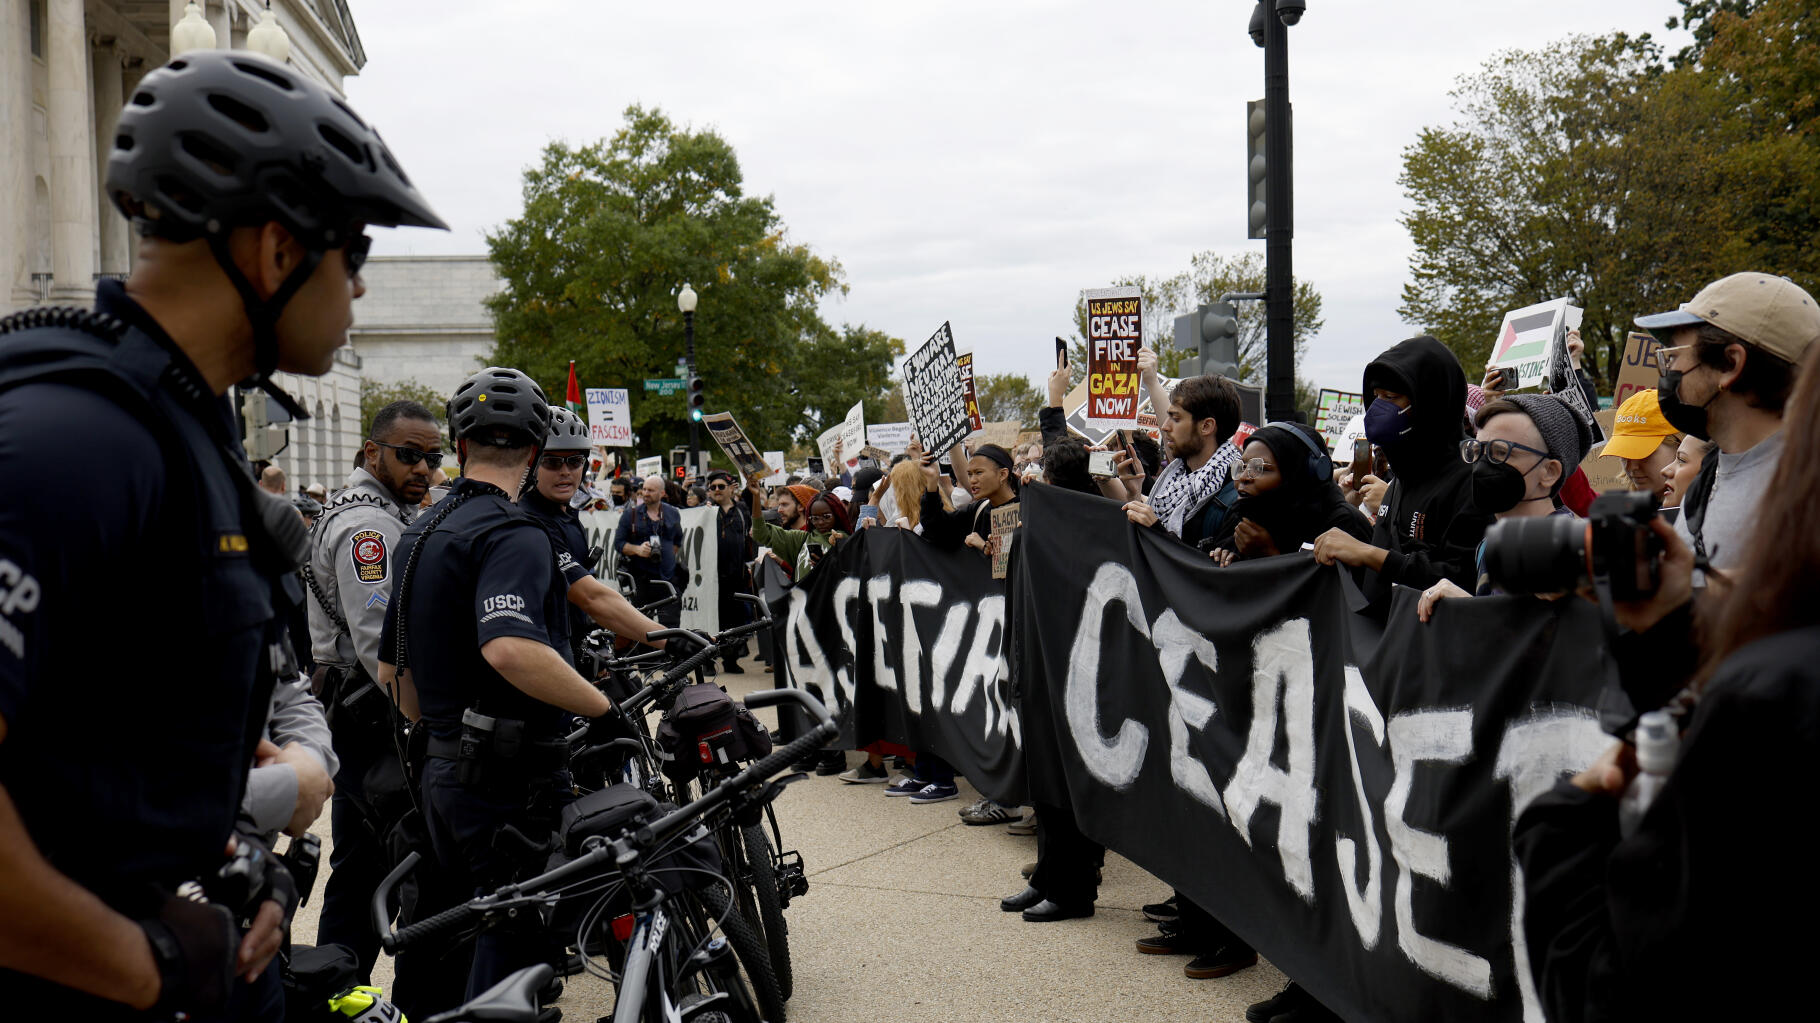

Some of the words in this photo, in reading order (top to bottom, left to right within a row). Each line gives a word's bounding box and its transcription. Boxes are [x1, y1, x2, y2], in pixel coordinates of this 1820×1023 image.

[1102, 301, 1124, 314] JEWS
[1124, 300, 1138, 313] SAY
[1091, 316, 1139, 337] CEASE
[911, 342, 930, 376] YOU
[928, 323, 949, 358] ARE
[1095, 340, 1136, 361] FIRE
[909, 342, 954, 398] NEUTRAL
[1111, 362, 1121, 371] IN
[1090, 374, 1138, 394] GAZA
[587, 391, 625, 404] ZIONISM
[942, 407, 950, 420] OF
[951, 396, 964, 413] THE
[1096, 398, 1132, 415] NOW!
[1332, 404, 1363, 415] JEWISH
[1328, 413, 1353, 422] SOLIDA
[592, 426, 629, 440] FASCISM
[922, 408, 966, 452] OPPRESSOR
[676, 466, 685, 478] 15
[354, 532, 381, 541] POLICE
[558, 552, 572, 566] SCP
[0, 559, 41, 616] CP
[484, 594, 526, 613] USCP
[682, 597, 698, 612] AZA
[649, 910, 668, 955] POLICE
